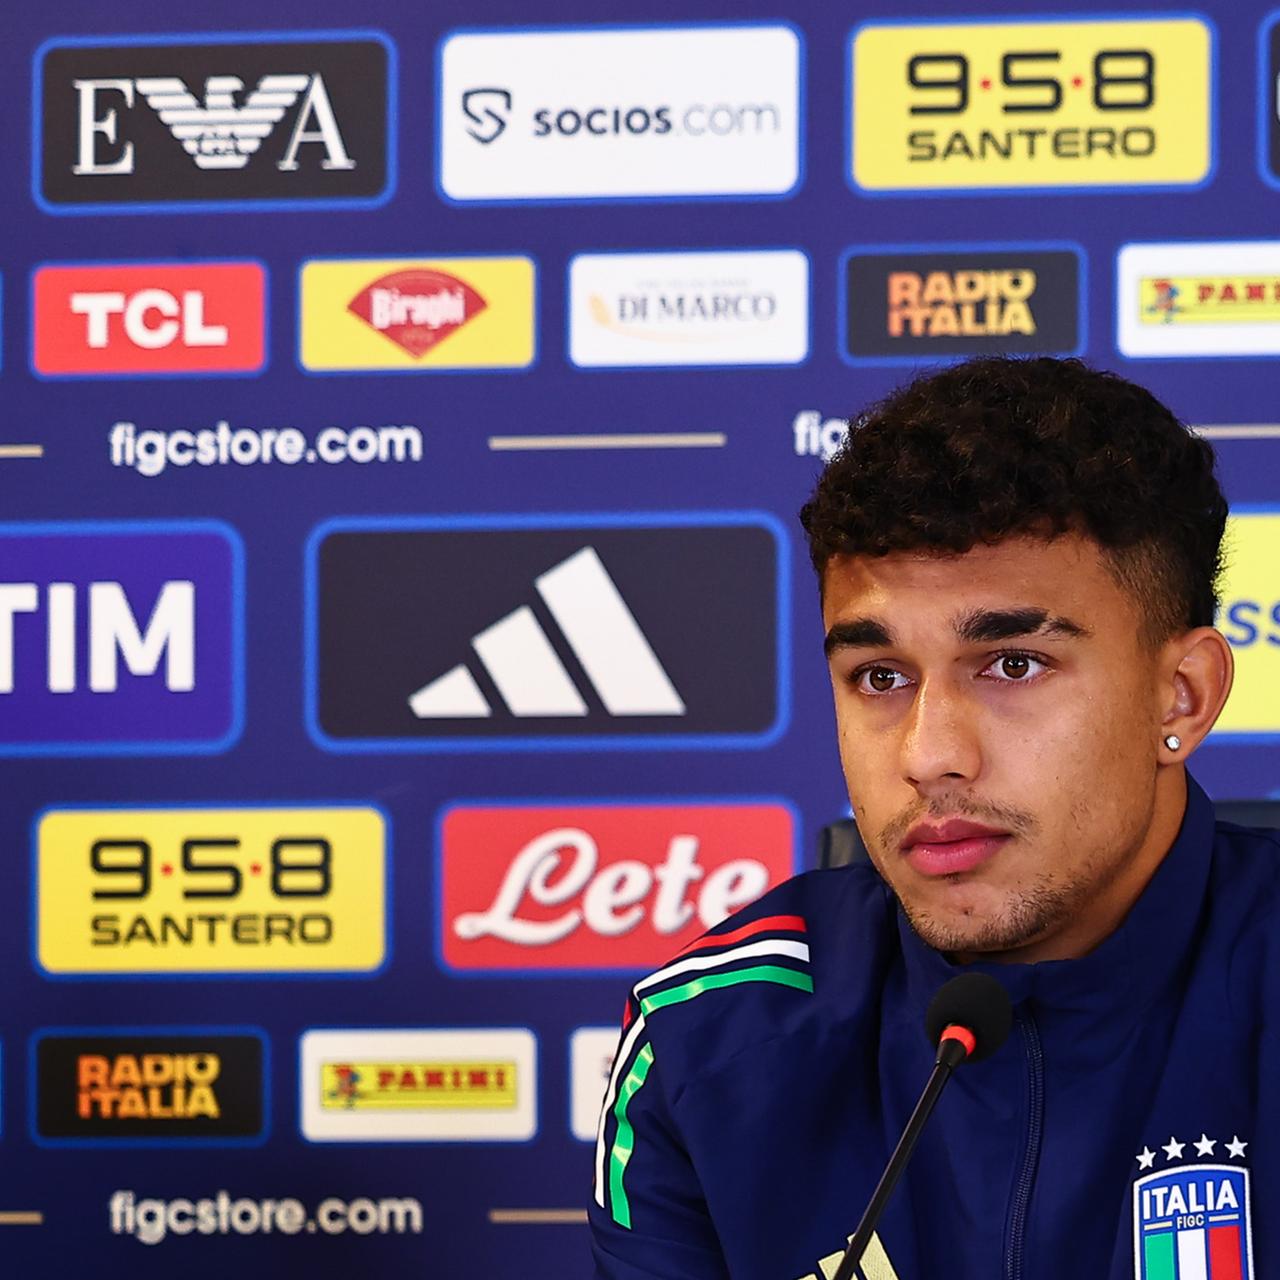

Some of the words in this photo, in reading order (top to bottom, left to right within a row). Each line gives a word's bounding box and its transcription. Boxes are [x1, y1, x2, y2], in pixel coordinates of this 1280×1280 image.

[533, 105, 781, 137] socios.com
[907, 126, 1156, 163] SANTERO
[888, 270, 1037, 306] RADIO
[71, 291, 229, 350] TCL
[657, 290, 778, 322] MARCO
[888, 302, 1037, 337] ITALIA
[109, 420, 423, 477] figcstore.com
[453, 828, 768, 944] Lete
[89, 913, 333, 946] SANTERO
[77, 1054, 220, 1087] RADIO
[378, 1069, 507, 1092] PANINI
[77, 1085, 220, 1120] ITALIA
[1143, 1179, 1239, 1220] ITALIA
[110, 1190, 423, 1246] figcstore.com
[1177, 1214, 1205, 1230] FIGC
